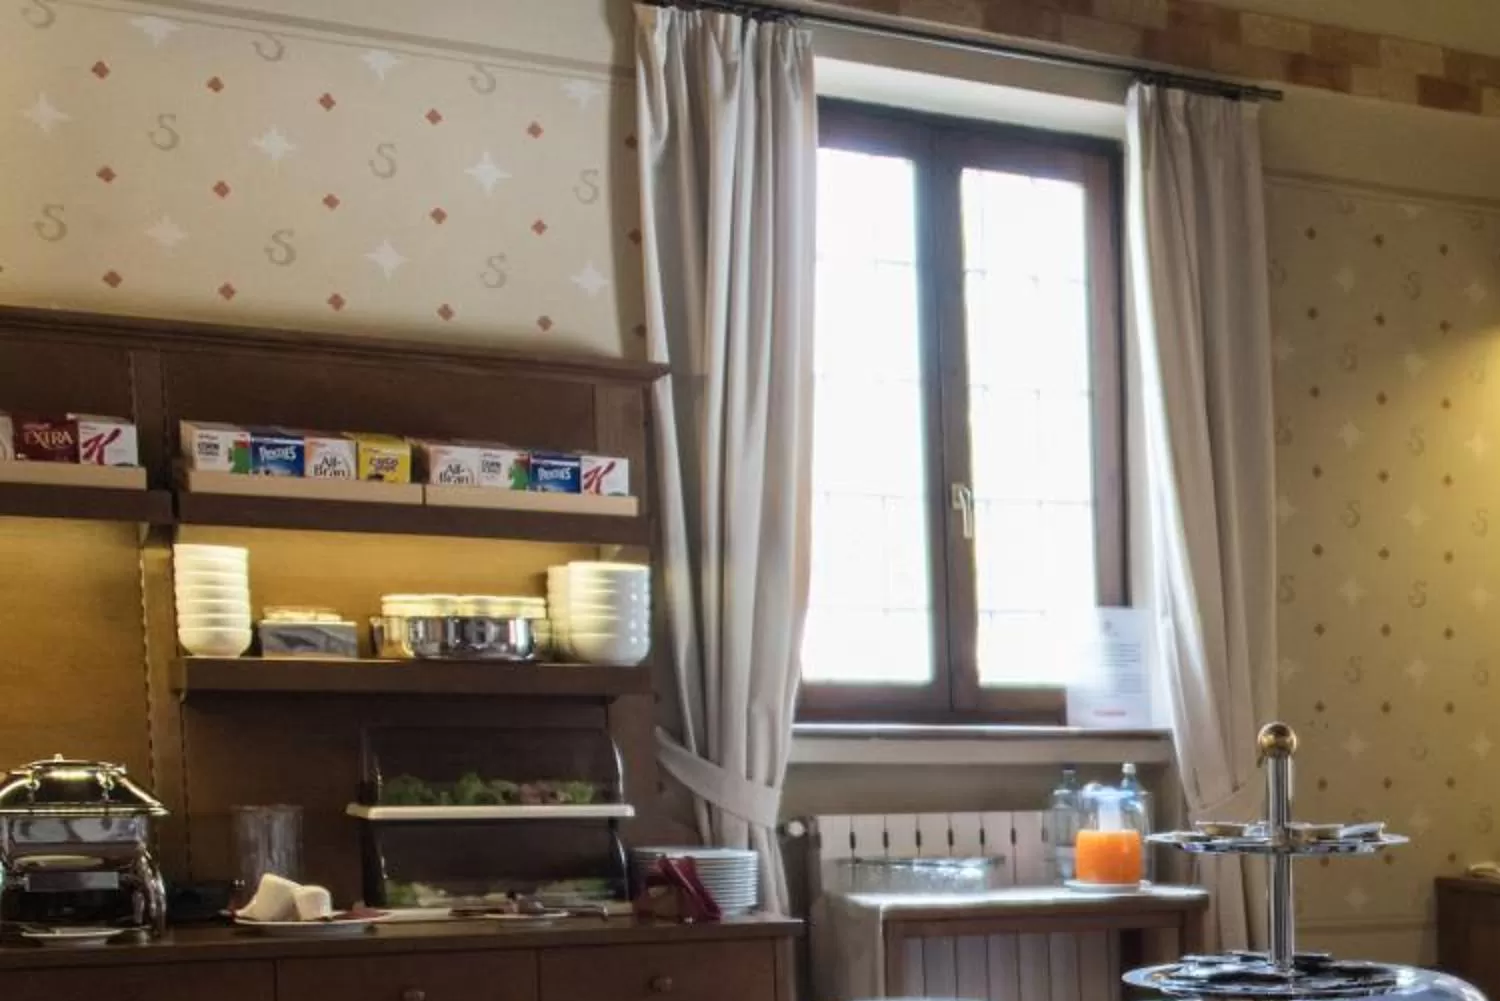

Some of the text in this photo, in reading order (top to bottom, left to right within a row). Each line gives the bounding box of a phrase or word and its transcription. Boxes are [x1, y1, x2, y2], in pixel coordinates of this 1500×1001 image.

[468, 64, 497, 94] S
[148, 113, 180, 151] S
[368, 143, 398, 179] S
[573, 169, 600, 204] S
[33, 204, 68, 242] S
[265, 229, 296, 266] S
[480, 253, 507, 288] S
